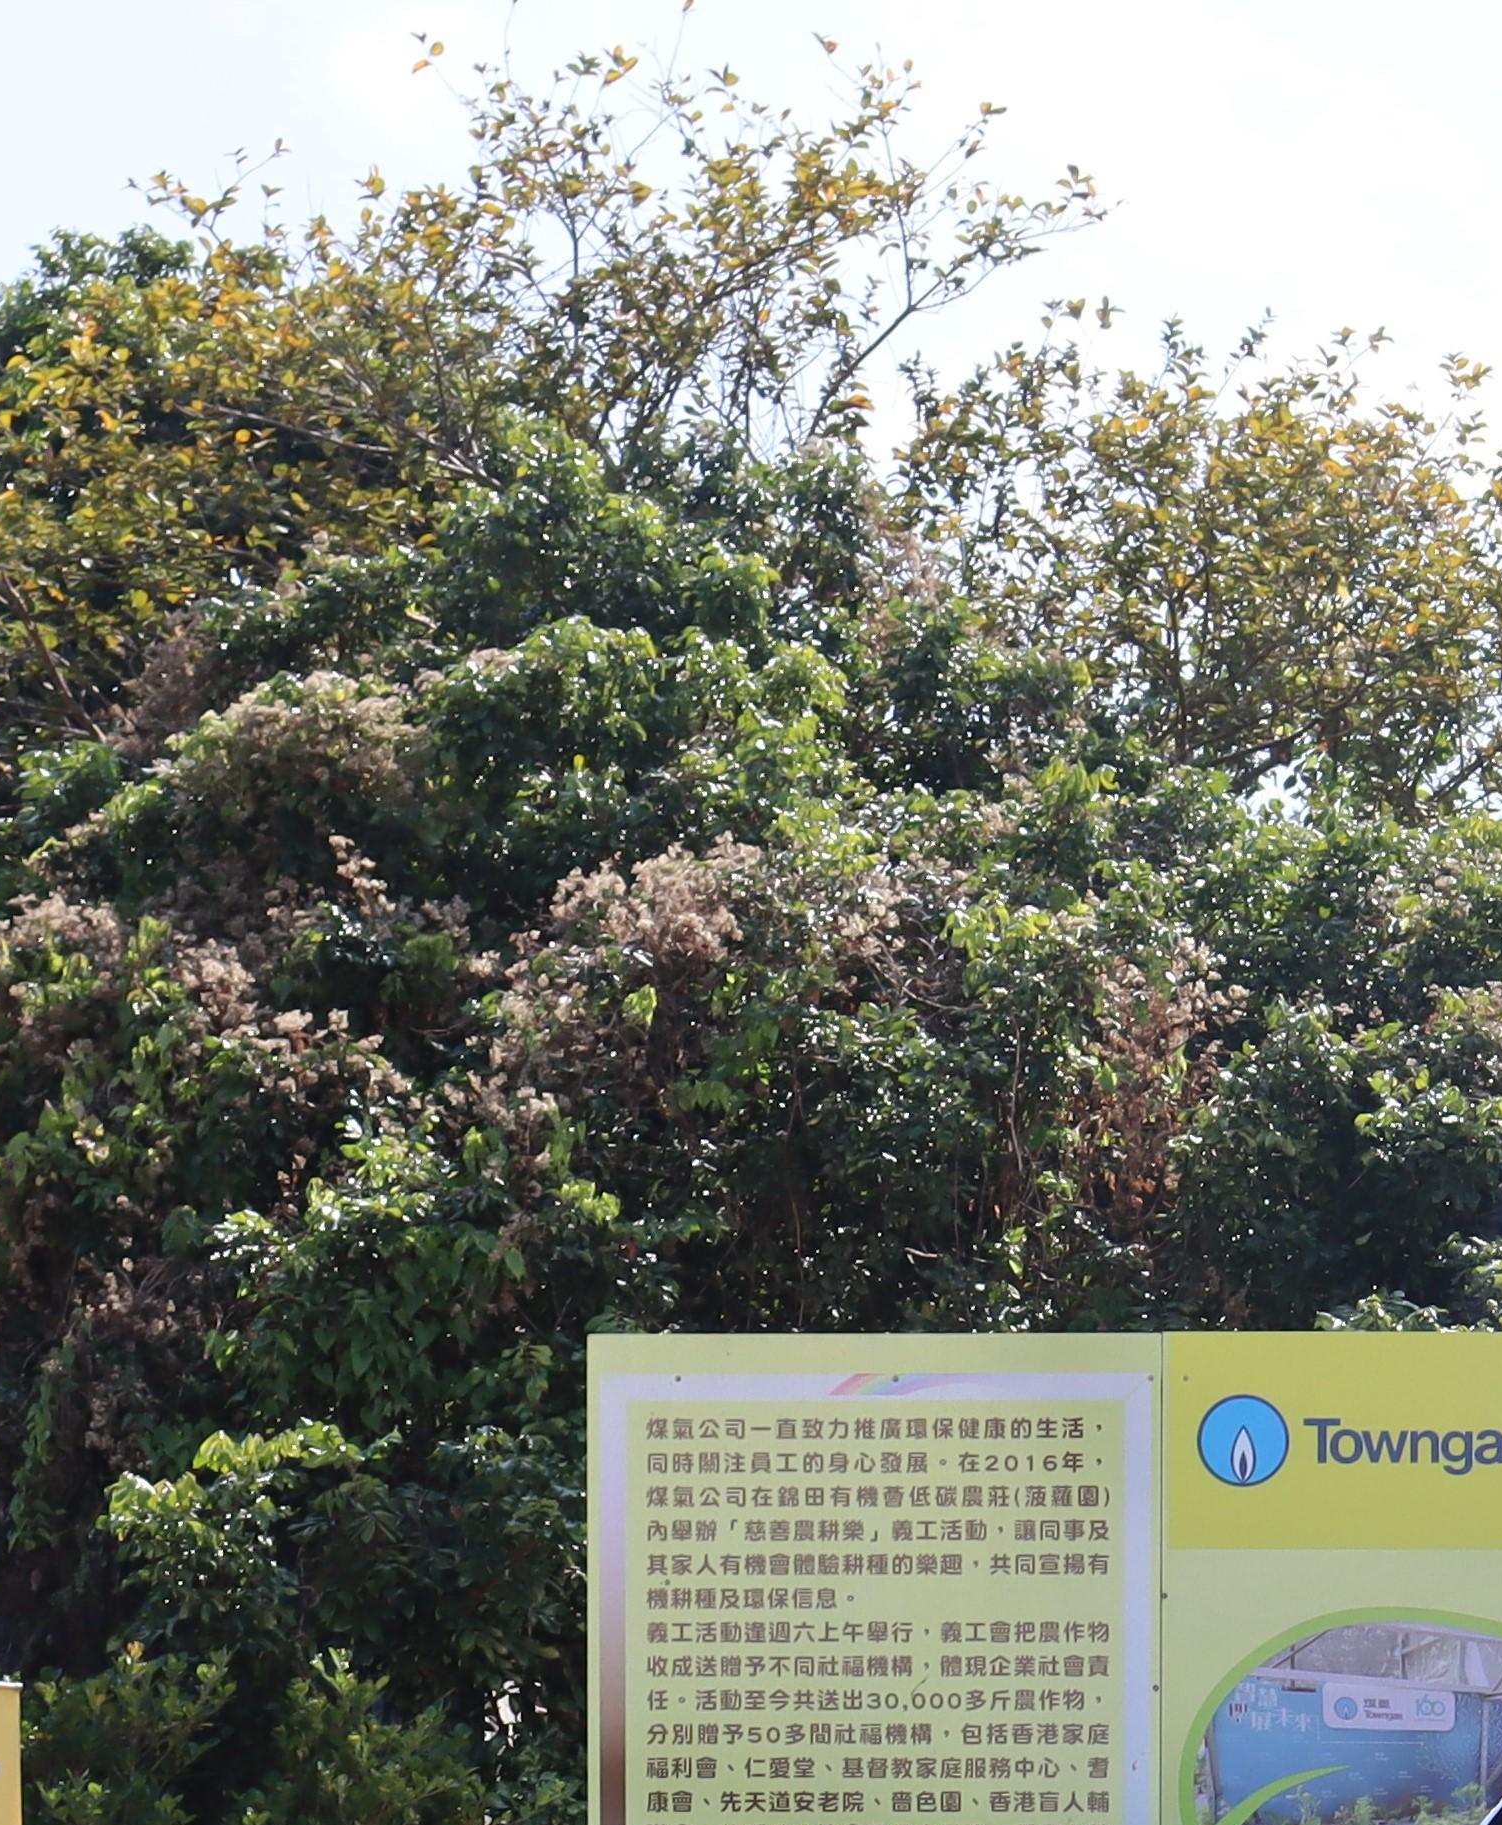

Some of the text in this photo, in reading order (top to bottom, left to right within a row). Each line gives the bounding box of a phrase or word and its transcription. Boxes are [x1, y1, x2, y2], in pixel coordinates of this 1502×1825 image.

[647, 1586, 855, 1610] 機耕種及環保信息。
